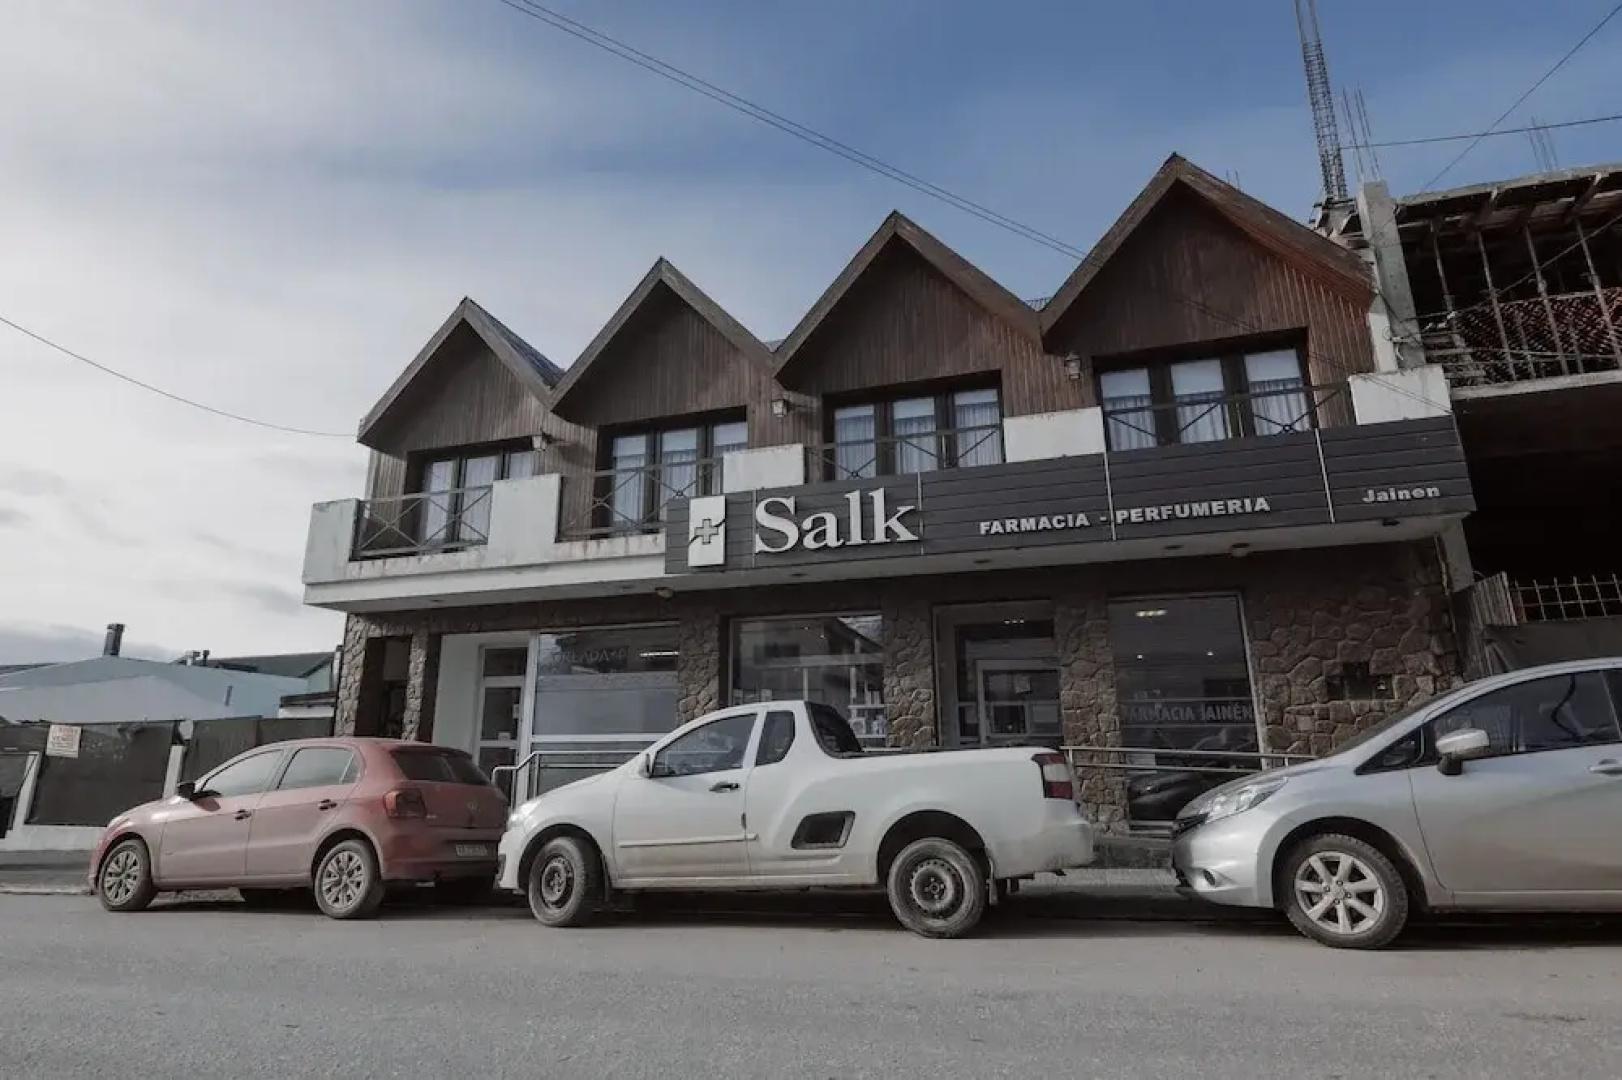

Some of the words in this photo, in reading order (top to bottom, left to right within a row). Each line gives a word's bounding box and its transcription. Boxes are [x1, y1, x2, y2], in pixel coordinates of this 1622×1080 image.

[1361, 487, 1441, 503] Jainen
[755, 487, 919, 554] Salk
[979, 513, 1091, 535] FARMACIA
[1115, 497, 1271, 525] PERFUMERIA
